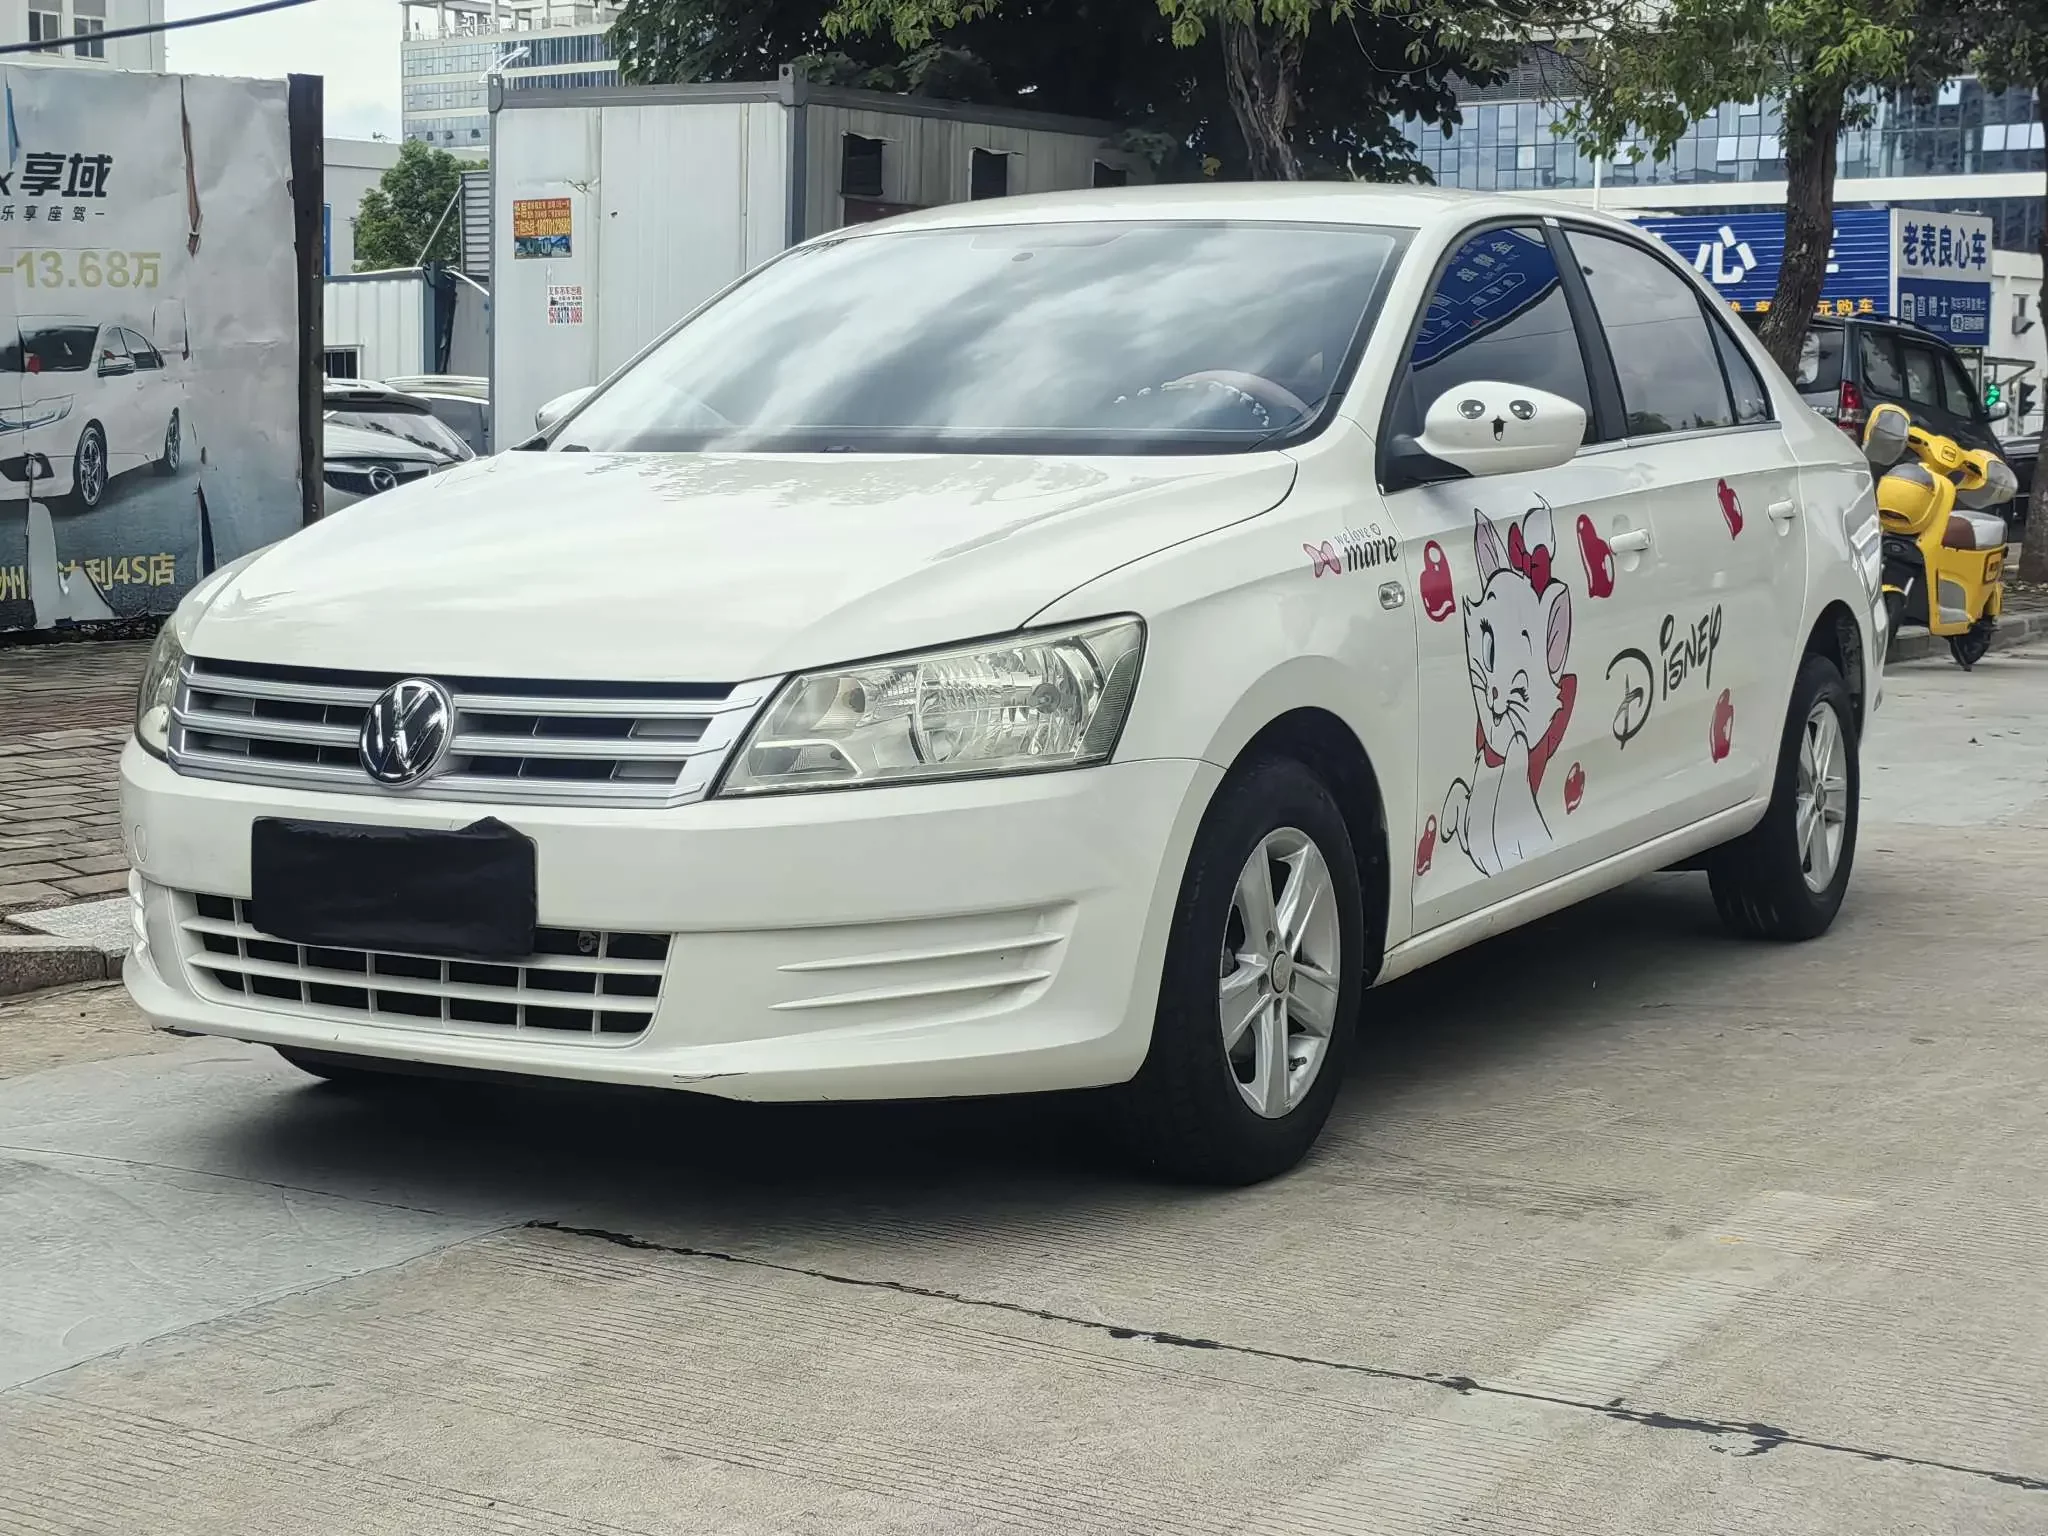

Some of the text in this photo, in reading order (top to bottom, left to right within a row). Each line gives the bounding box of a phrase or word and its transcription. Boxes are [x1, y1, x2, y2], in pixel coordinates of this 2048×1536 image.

[20, 152, 113, 198] 享域
[1902, 220, 1987, 271] 老表良心车
[1817, 298, 1874, 317] 元购车
[1343, 535, 1398, 572] marie
